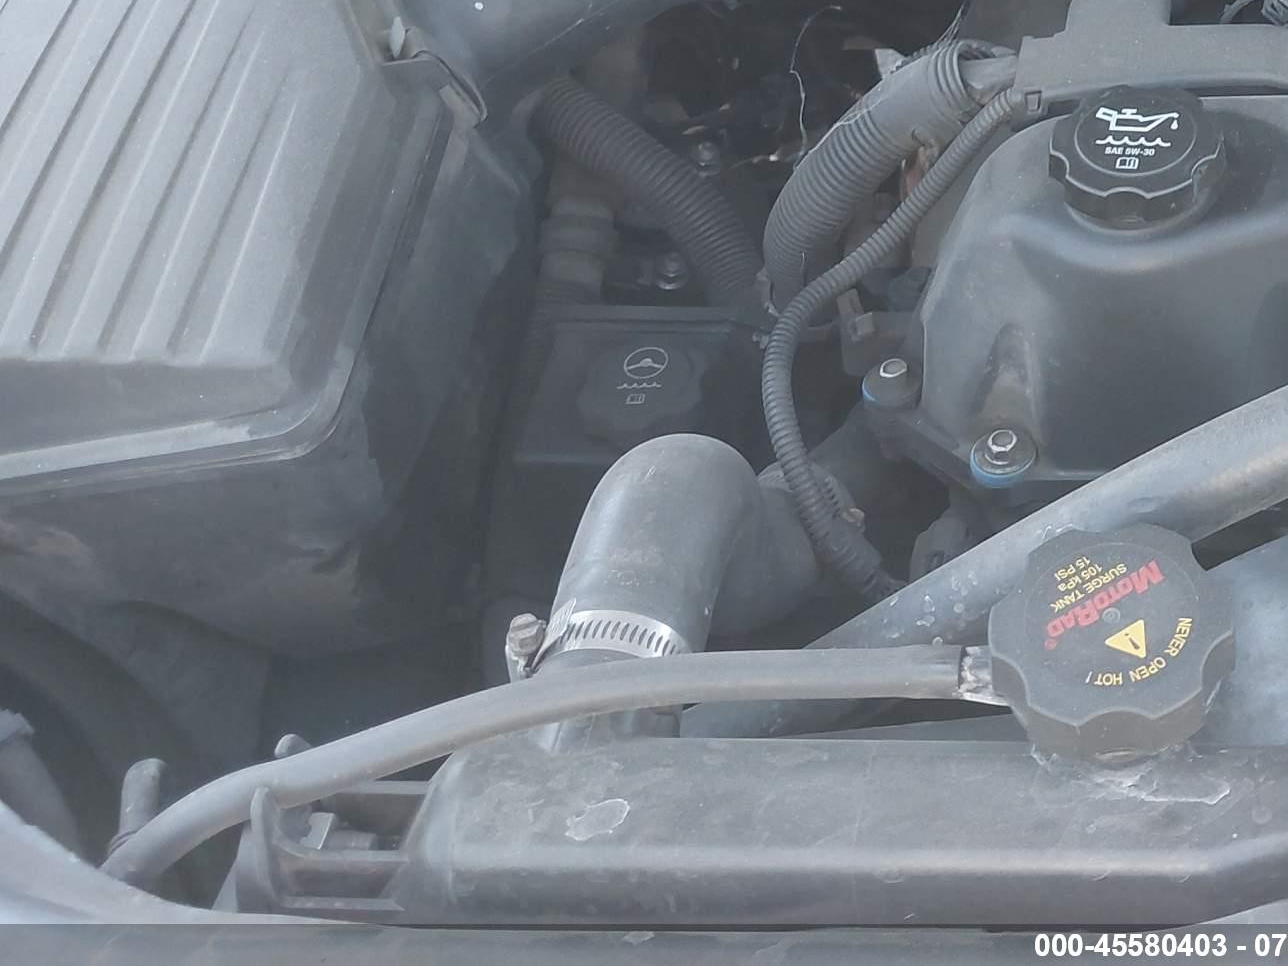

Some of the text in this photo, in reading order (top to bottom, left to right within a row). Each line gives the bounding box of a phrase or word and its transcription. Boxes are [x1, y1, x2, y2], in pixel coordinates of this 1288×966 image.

[1104, 147, 1155, 156] SAE 5W-30
[1053, 555, 1091, 581] 15 PSI
[1056, 562, 1103, 593] 105 kPa
[1049, 562, 1128, 613] SURGE TANK
[1163, 616, 1193, 657] NEVER
[1129, 655, 1167, 682] OPEN
